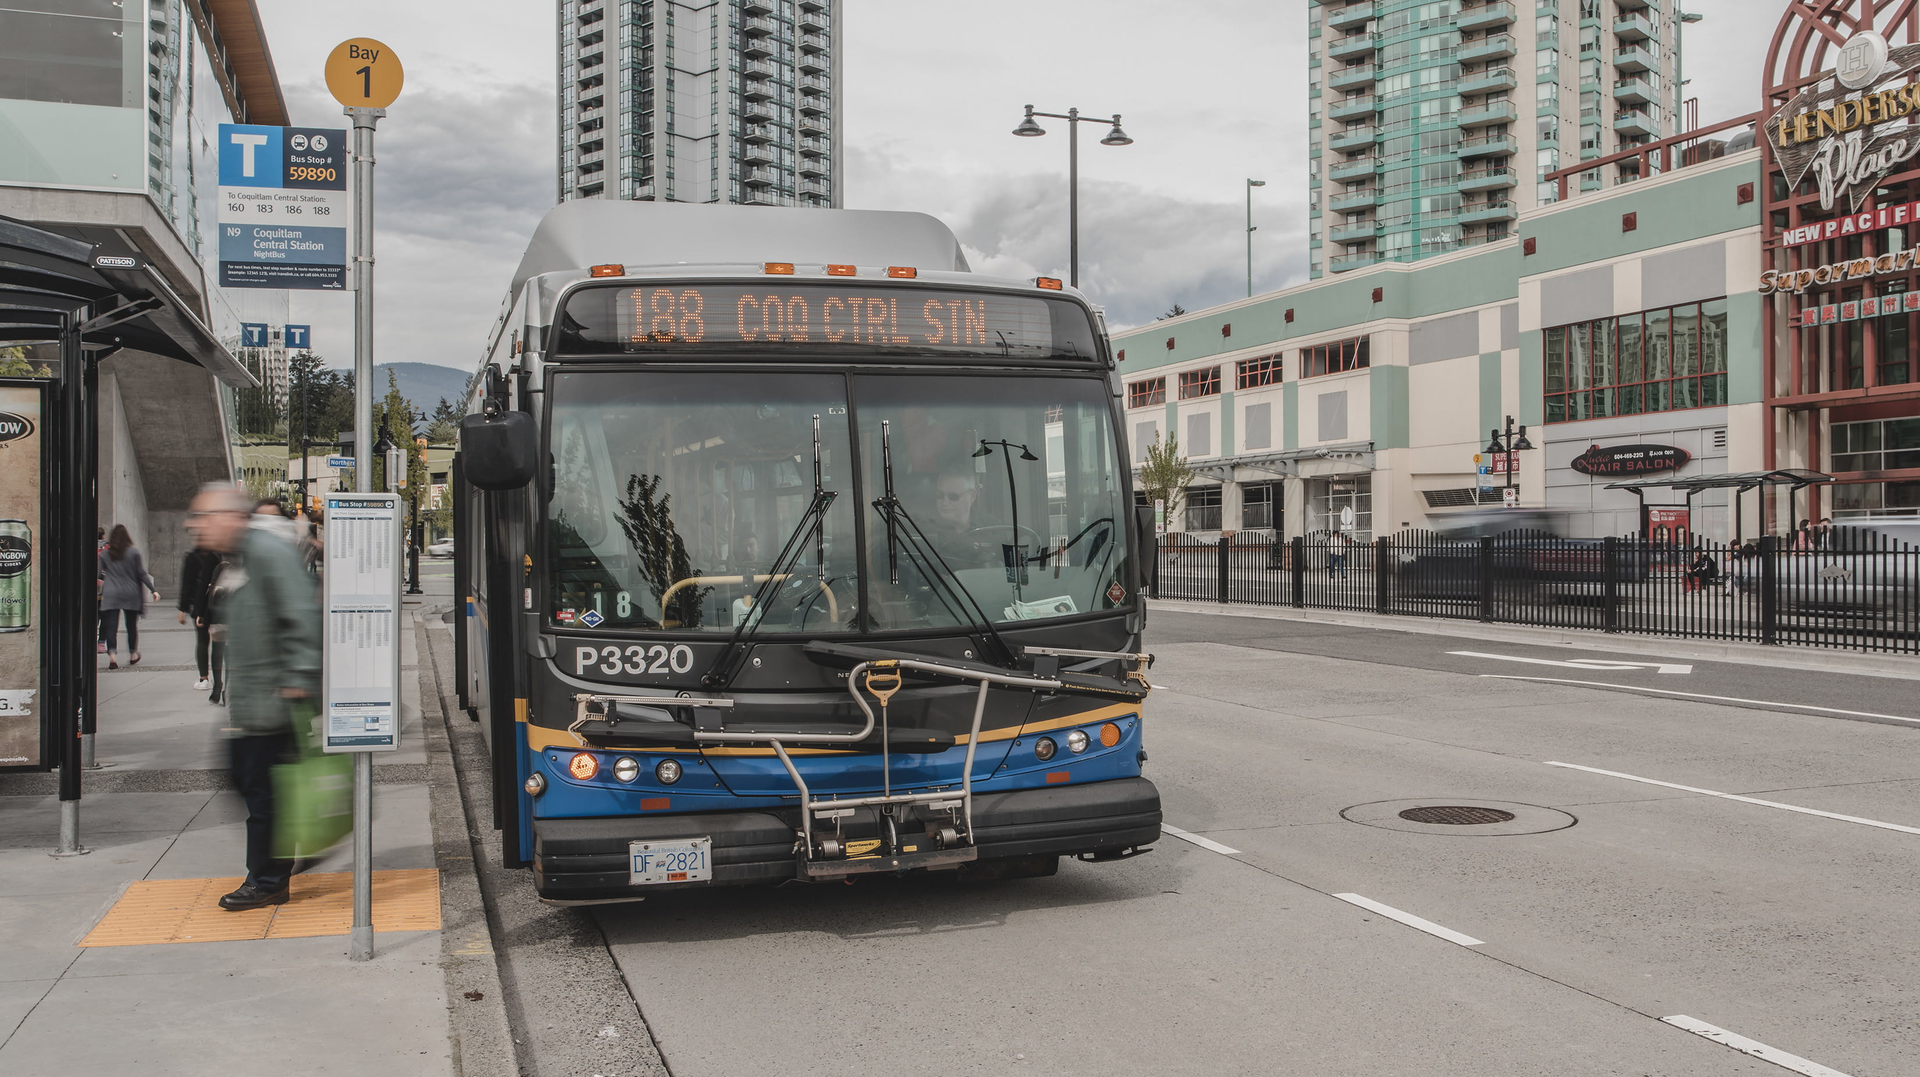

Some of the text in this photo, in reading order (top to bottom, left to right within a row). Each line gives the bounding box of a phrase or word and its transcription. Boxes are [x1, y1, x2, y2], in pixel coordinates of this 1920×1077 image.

[350, 44, 379, 64] Bay
[1841, 42, 1869, 75] H
[356, 66, 370, 98] 1
[231, 134, 268, 178] T
[290, 155, 306, 163] Bus
[307, 156, 325, 165] Stop
[290, 166, 336, 181] 59890
[1812, 137, 1920, 211] Place
[237, 192, 272, 201] Coquitlam
[228, 203, 330, 215] 160 183 186 188
[227, 227, 302, 239] N9 Coquitlam
[1783, 224, 1821, 246] NEW
[254, 239, 324, 250] Central Station
[254, 251, 286, 259] NightBus
[630, 288, 986, 344] 188 COQ CTRL STN
[247, 327, 261, 342] T
[290, 328, 304, 344] T
[1588, 458, 1674, 473] HAIR SALON
[617, 591, 631, 618] 8
[576, 644, 694, 675] P3320
[633, 851, 705, 873] DF 2821
